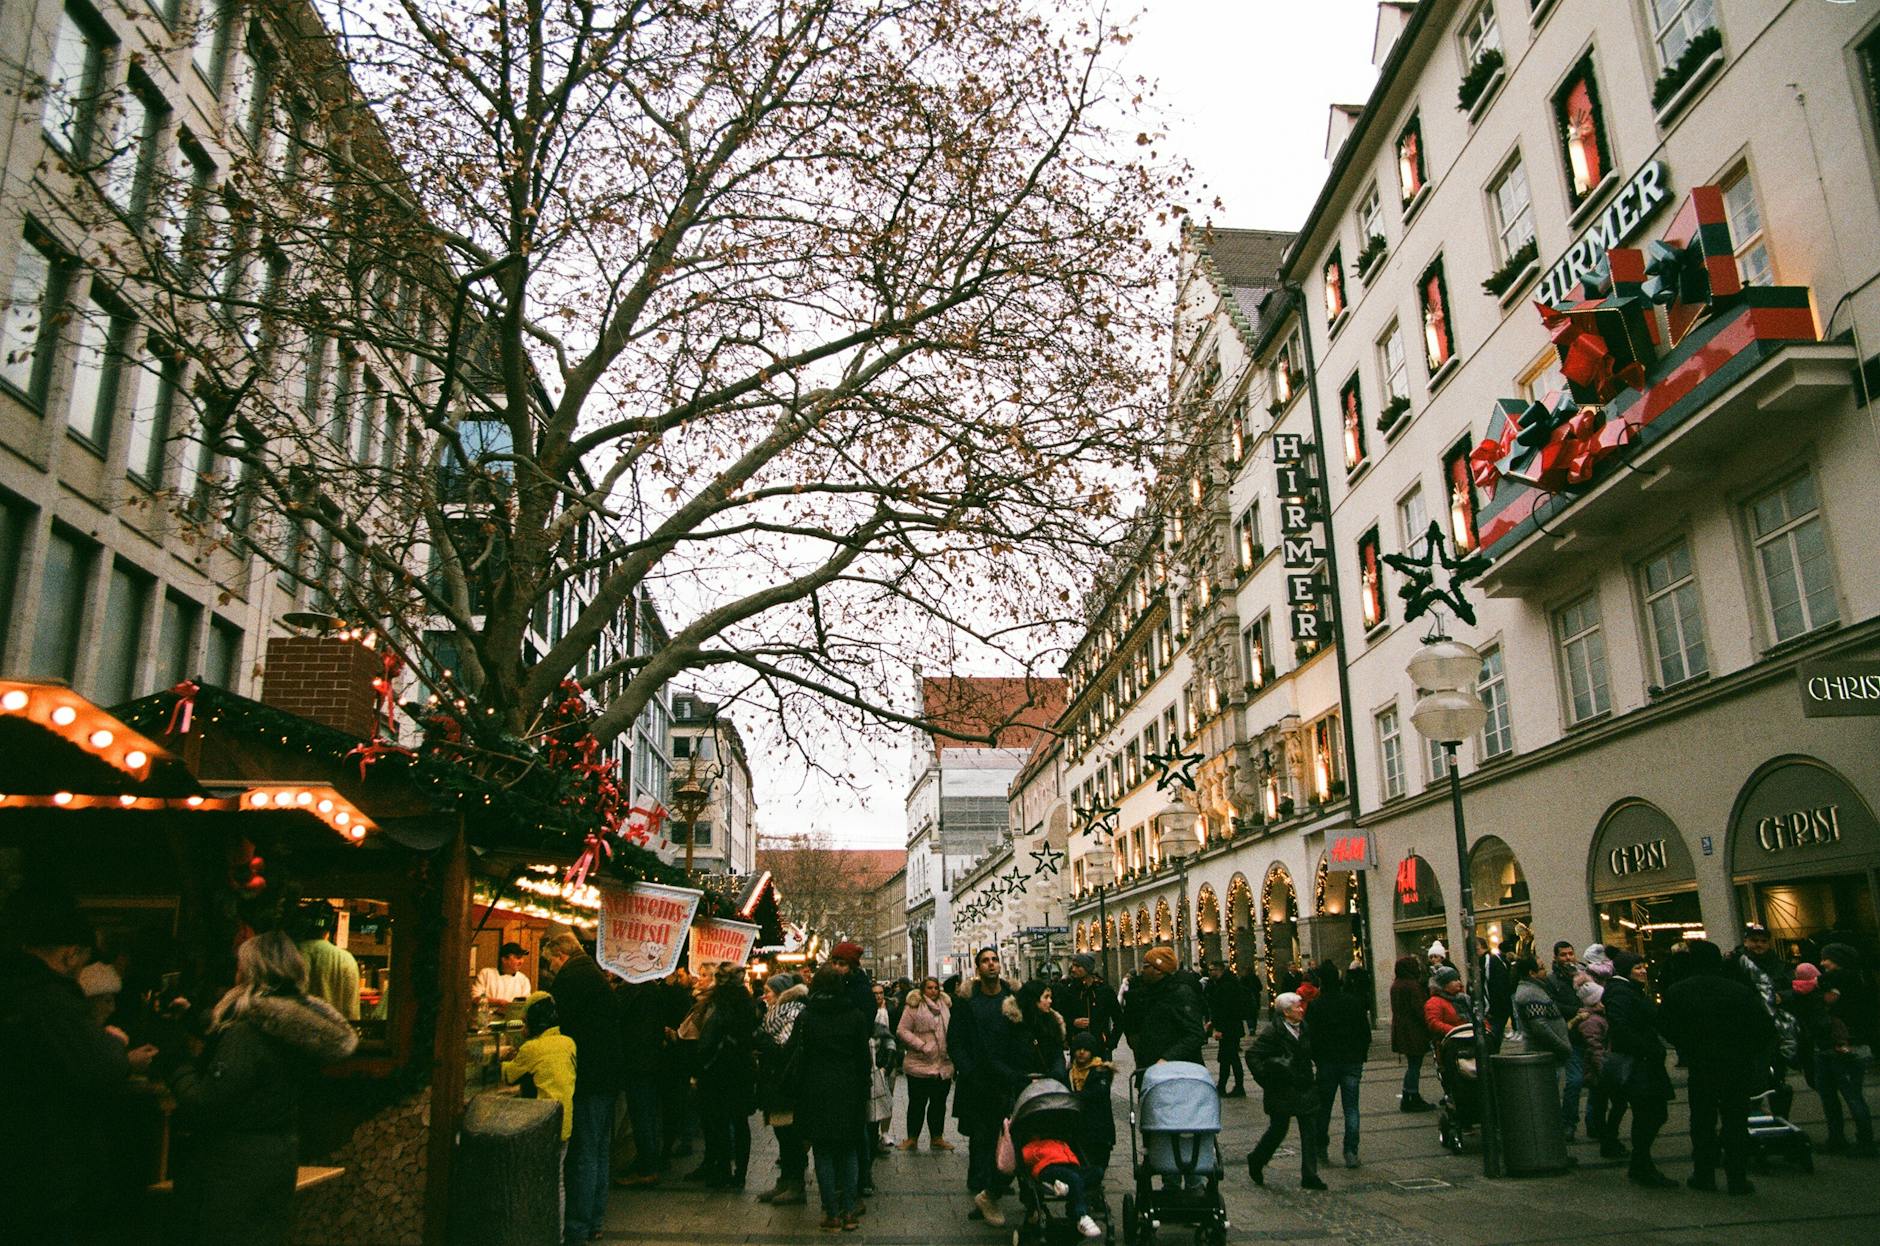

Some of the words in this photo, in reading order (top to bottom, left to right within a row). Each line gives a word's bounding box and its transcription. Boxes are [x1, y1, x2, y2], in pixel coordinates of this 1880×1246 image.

[1535, 159, 1665, 308] HIRMER
[1275, 435, 1318, 637] HIRMER
[1330, 836, 1366, 864] H&M
[1758, 805, 1840, 852] CHRIST
[1610, 839, 1668, 876] CHRIST
